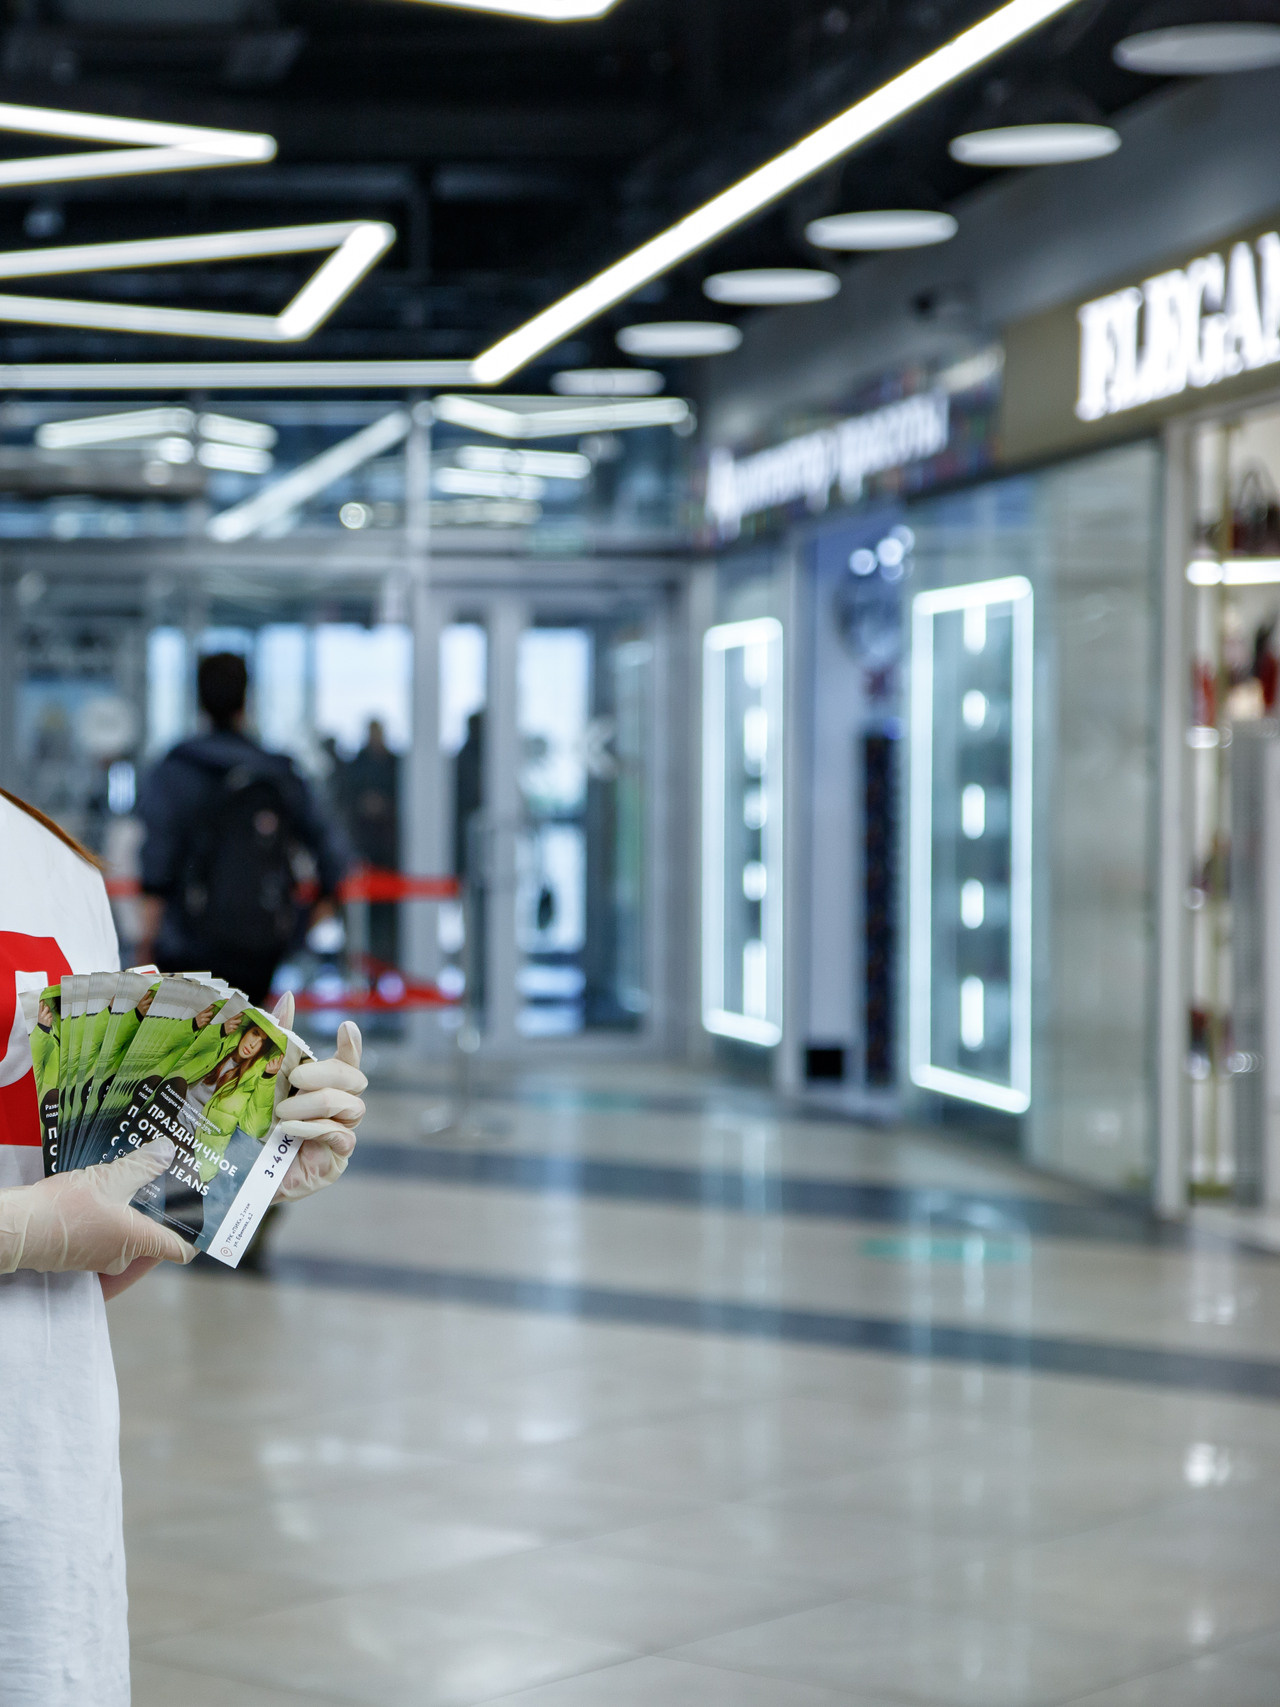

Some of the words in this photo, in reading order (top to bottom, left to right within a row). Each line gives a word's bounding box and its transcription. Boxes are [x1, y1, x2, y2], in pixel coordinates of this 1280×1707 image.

[138, 1119, 203, 1172] ОТКТИЕ
[147, 1104, 239, 1177] ПРАЗДНИЧНОЕ
[169, 1165, 211, 1196] JEANS
[264, 1169, 274, 1179] 3
[273, 1155, 283, 1164] 4
